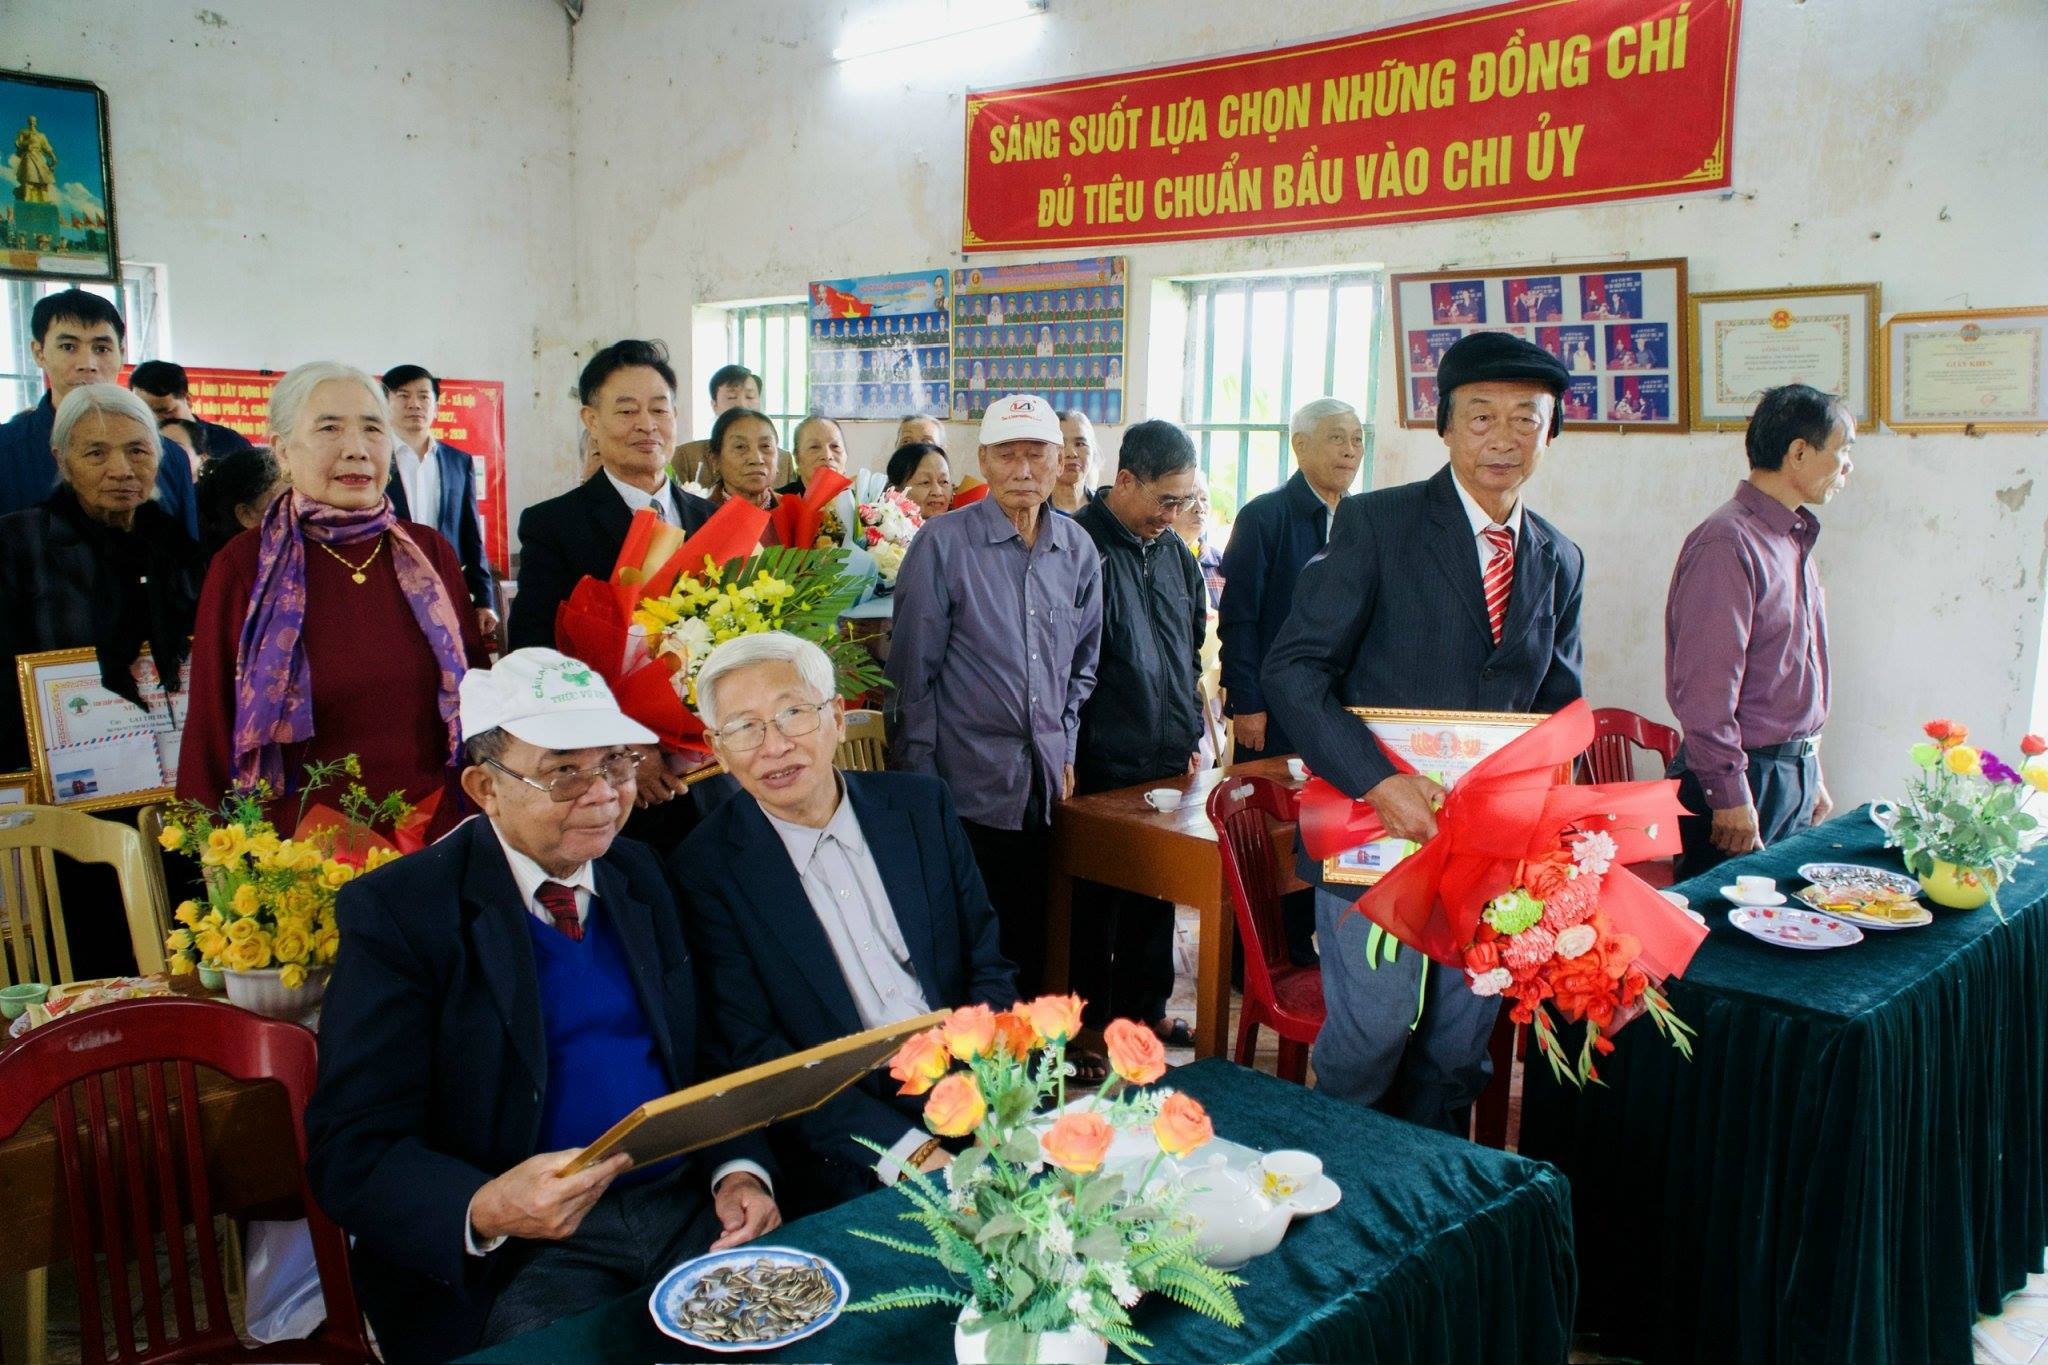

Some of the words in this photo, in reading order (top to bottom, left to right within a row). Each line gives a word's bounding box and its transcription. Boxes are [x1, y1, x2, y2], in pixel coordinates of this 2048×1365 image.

[990, 114, 1060, 165] SÁNG
[1069, 95, 1143, 157] SUỐT
[1150, 96, 1209, 155] LỰA
[1218, 82, 1312, 143] CHỌN
[1322, 58, 1456, 126] NHỮNG
[1468, 28, 1593, 103] ĐỒNG
[1607, 1, 1692, 80] CHÍ
[1038, 173, 1076, 228] ĐỦ
[1083, 174, 1145, 225] TIÊU
[1154, 151, 1263, 220] CHUẨN
[1273, 145, 1344, 210] BẦU
[1355, 141, 1429, 200] VÀO
[1443, 135, 1513, 192] CHI
[1526, 111, 1586, 182] ỦY
